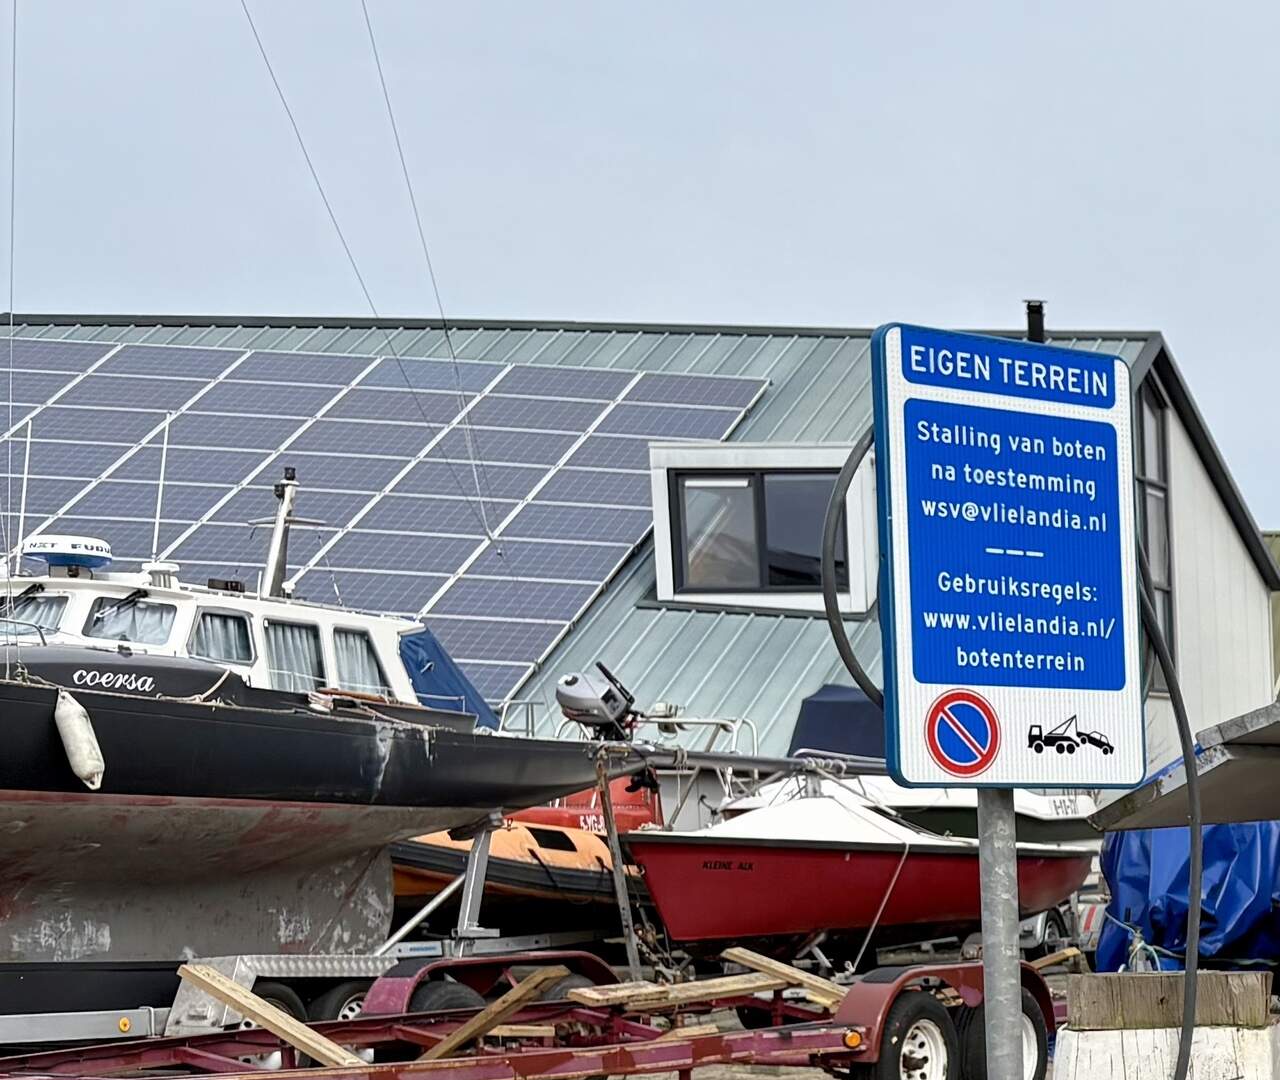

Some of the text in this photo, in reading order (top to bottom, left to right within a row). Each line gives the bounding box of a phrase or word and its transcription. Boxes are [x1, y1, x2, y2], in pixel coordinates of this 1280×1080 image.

[909, 345, 1109, 397] EIGEN TERREIN
[916, 420, 1106, 461] Stalling van boten
[931, 464, 1096, 501] na toestemming
[921, 501, 1107, 532] wsv@vlielandia.nl
[937, 571, 1098, 605] Gebruiksregels:
[923, 612, 1116, 640] www.vlielandia.nl/
[956, 646, 1085, 672] botenterrein
[73, 669, 155, 692] coersa
